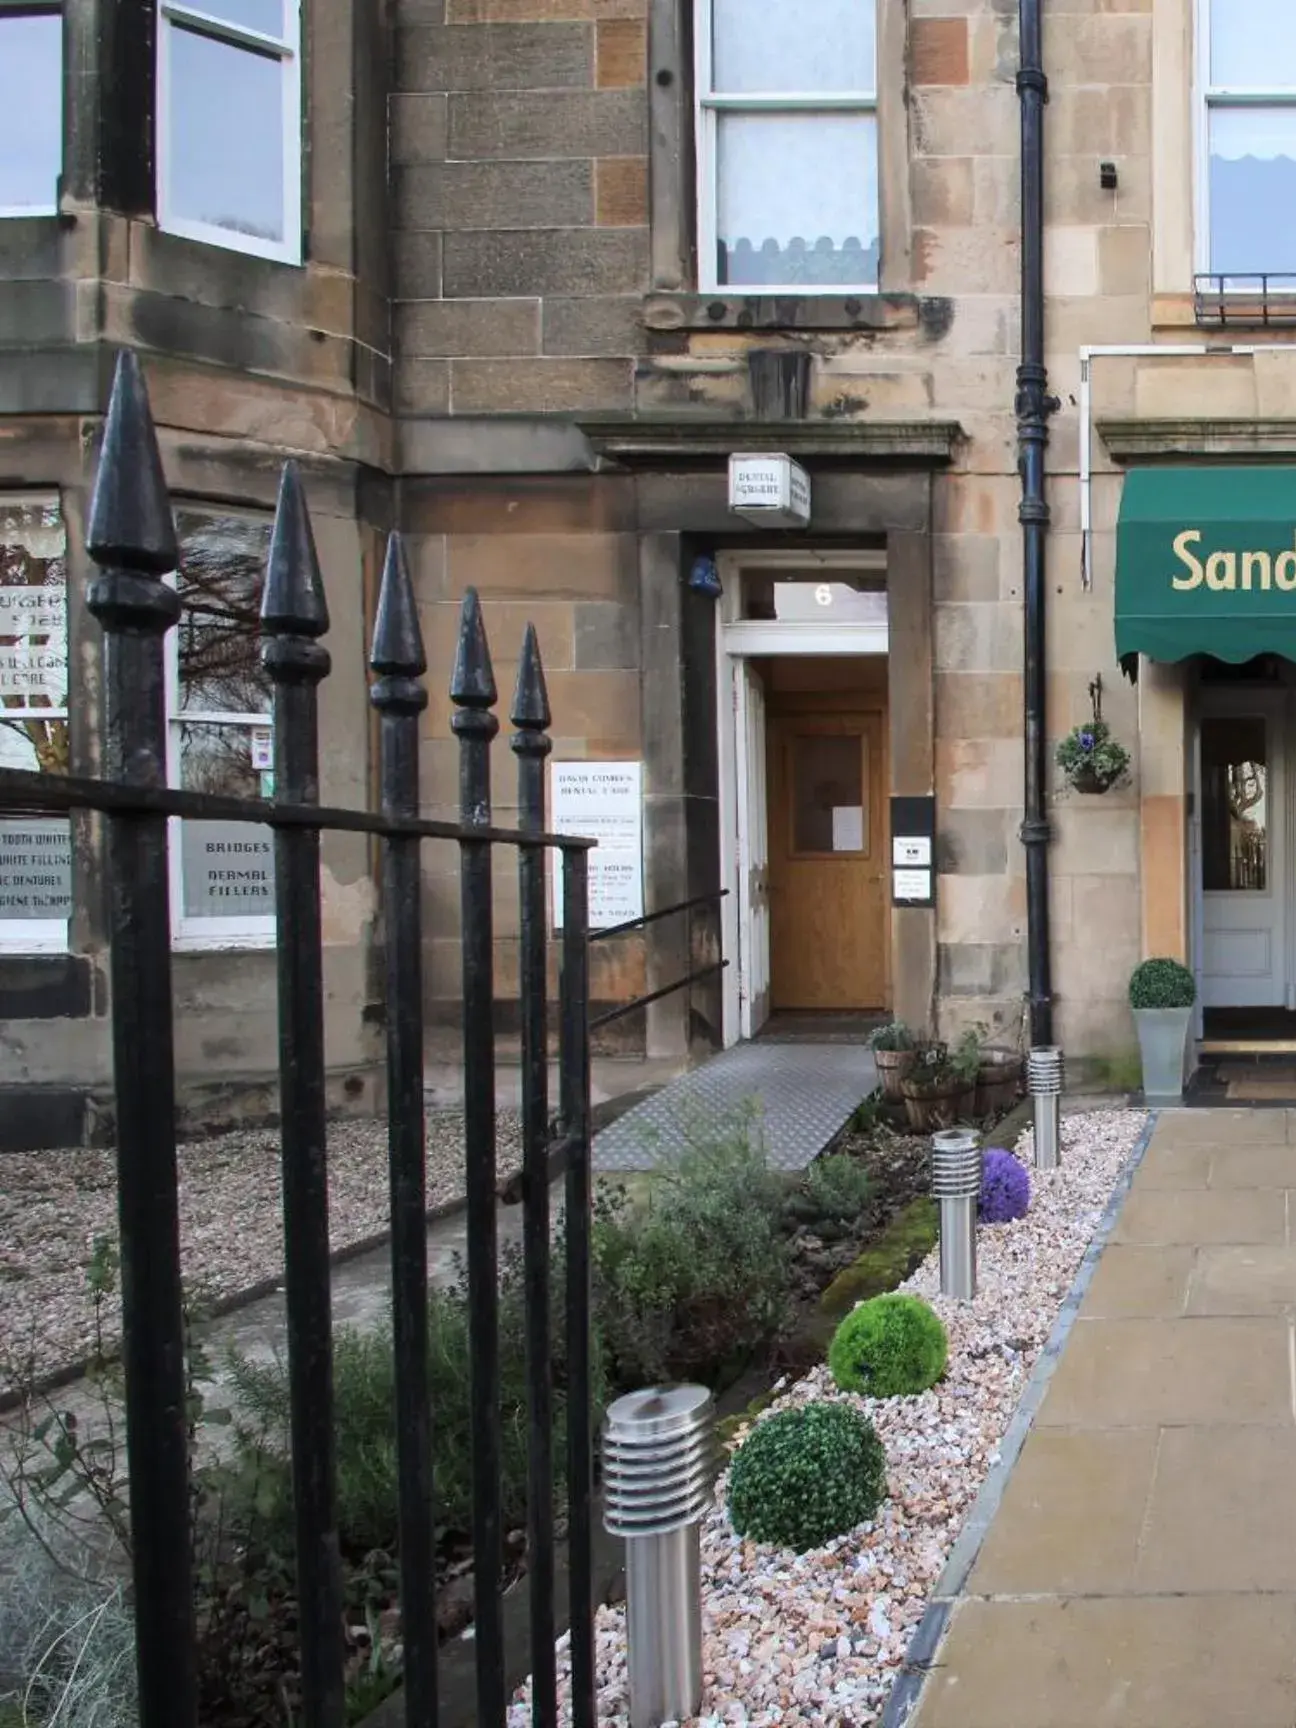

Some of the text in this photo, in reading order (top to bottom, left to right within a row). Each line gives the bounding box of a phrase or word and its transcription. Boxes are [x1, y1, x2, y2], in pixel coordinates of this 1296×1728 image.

[815, 584, 832, 606] 6
[206, 842, 271, 853] BRIDGES
[208, 870, 267, 881] DERMAL
[208, 886, 270, 897] FILLERS
